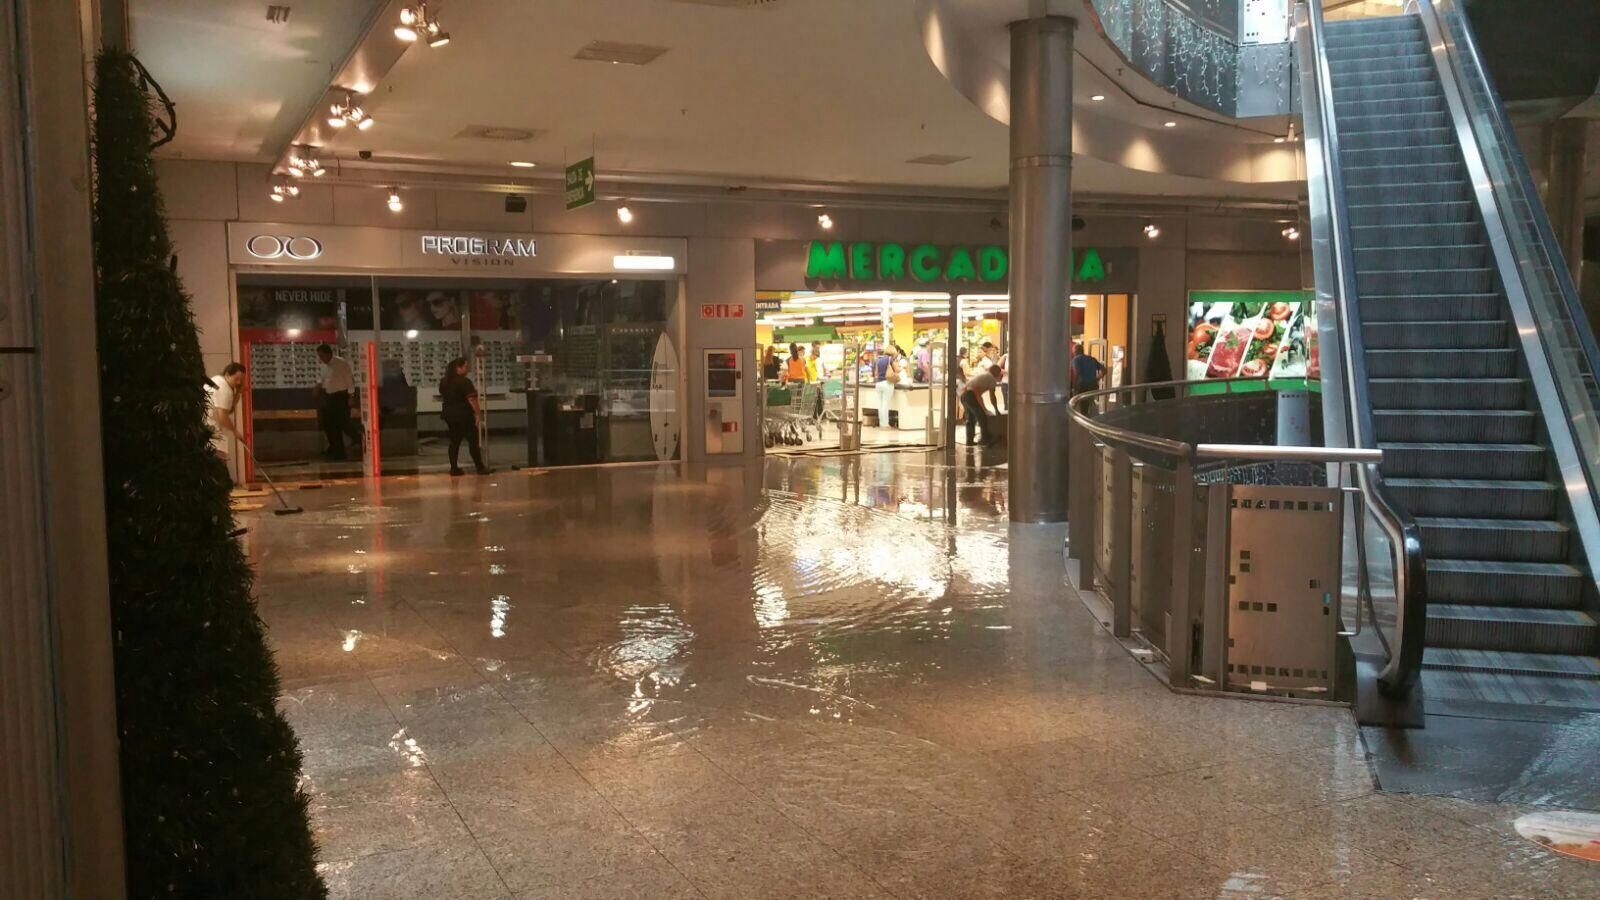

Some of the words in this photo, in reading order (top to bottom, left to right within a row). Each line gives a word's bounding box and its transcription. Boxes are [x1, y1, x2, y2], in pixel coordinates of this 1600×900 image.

[421, 235, 537, 257] PROGRAM
[451, 257, 515, 267] VISION
[805, 239, 1105, 282] MERCADA
[274, 289, 308, 302] NEVER
[310, 290, 333, 303] HIDE
